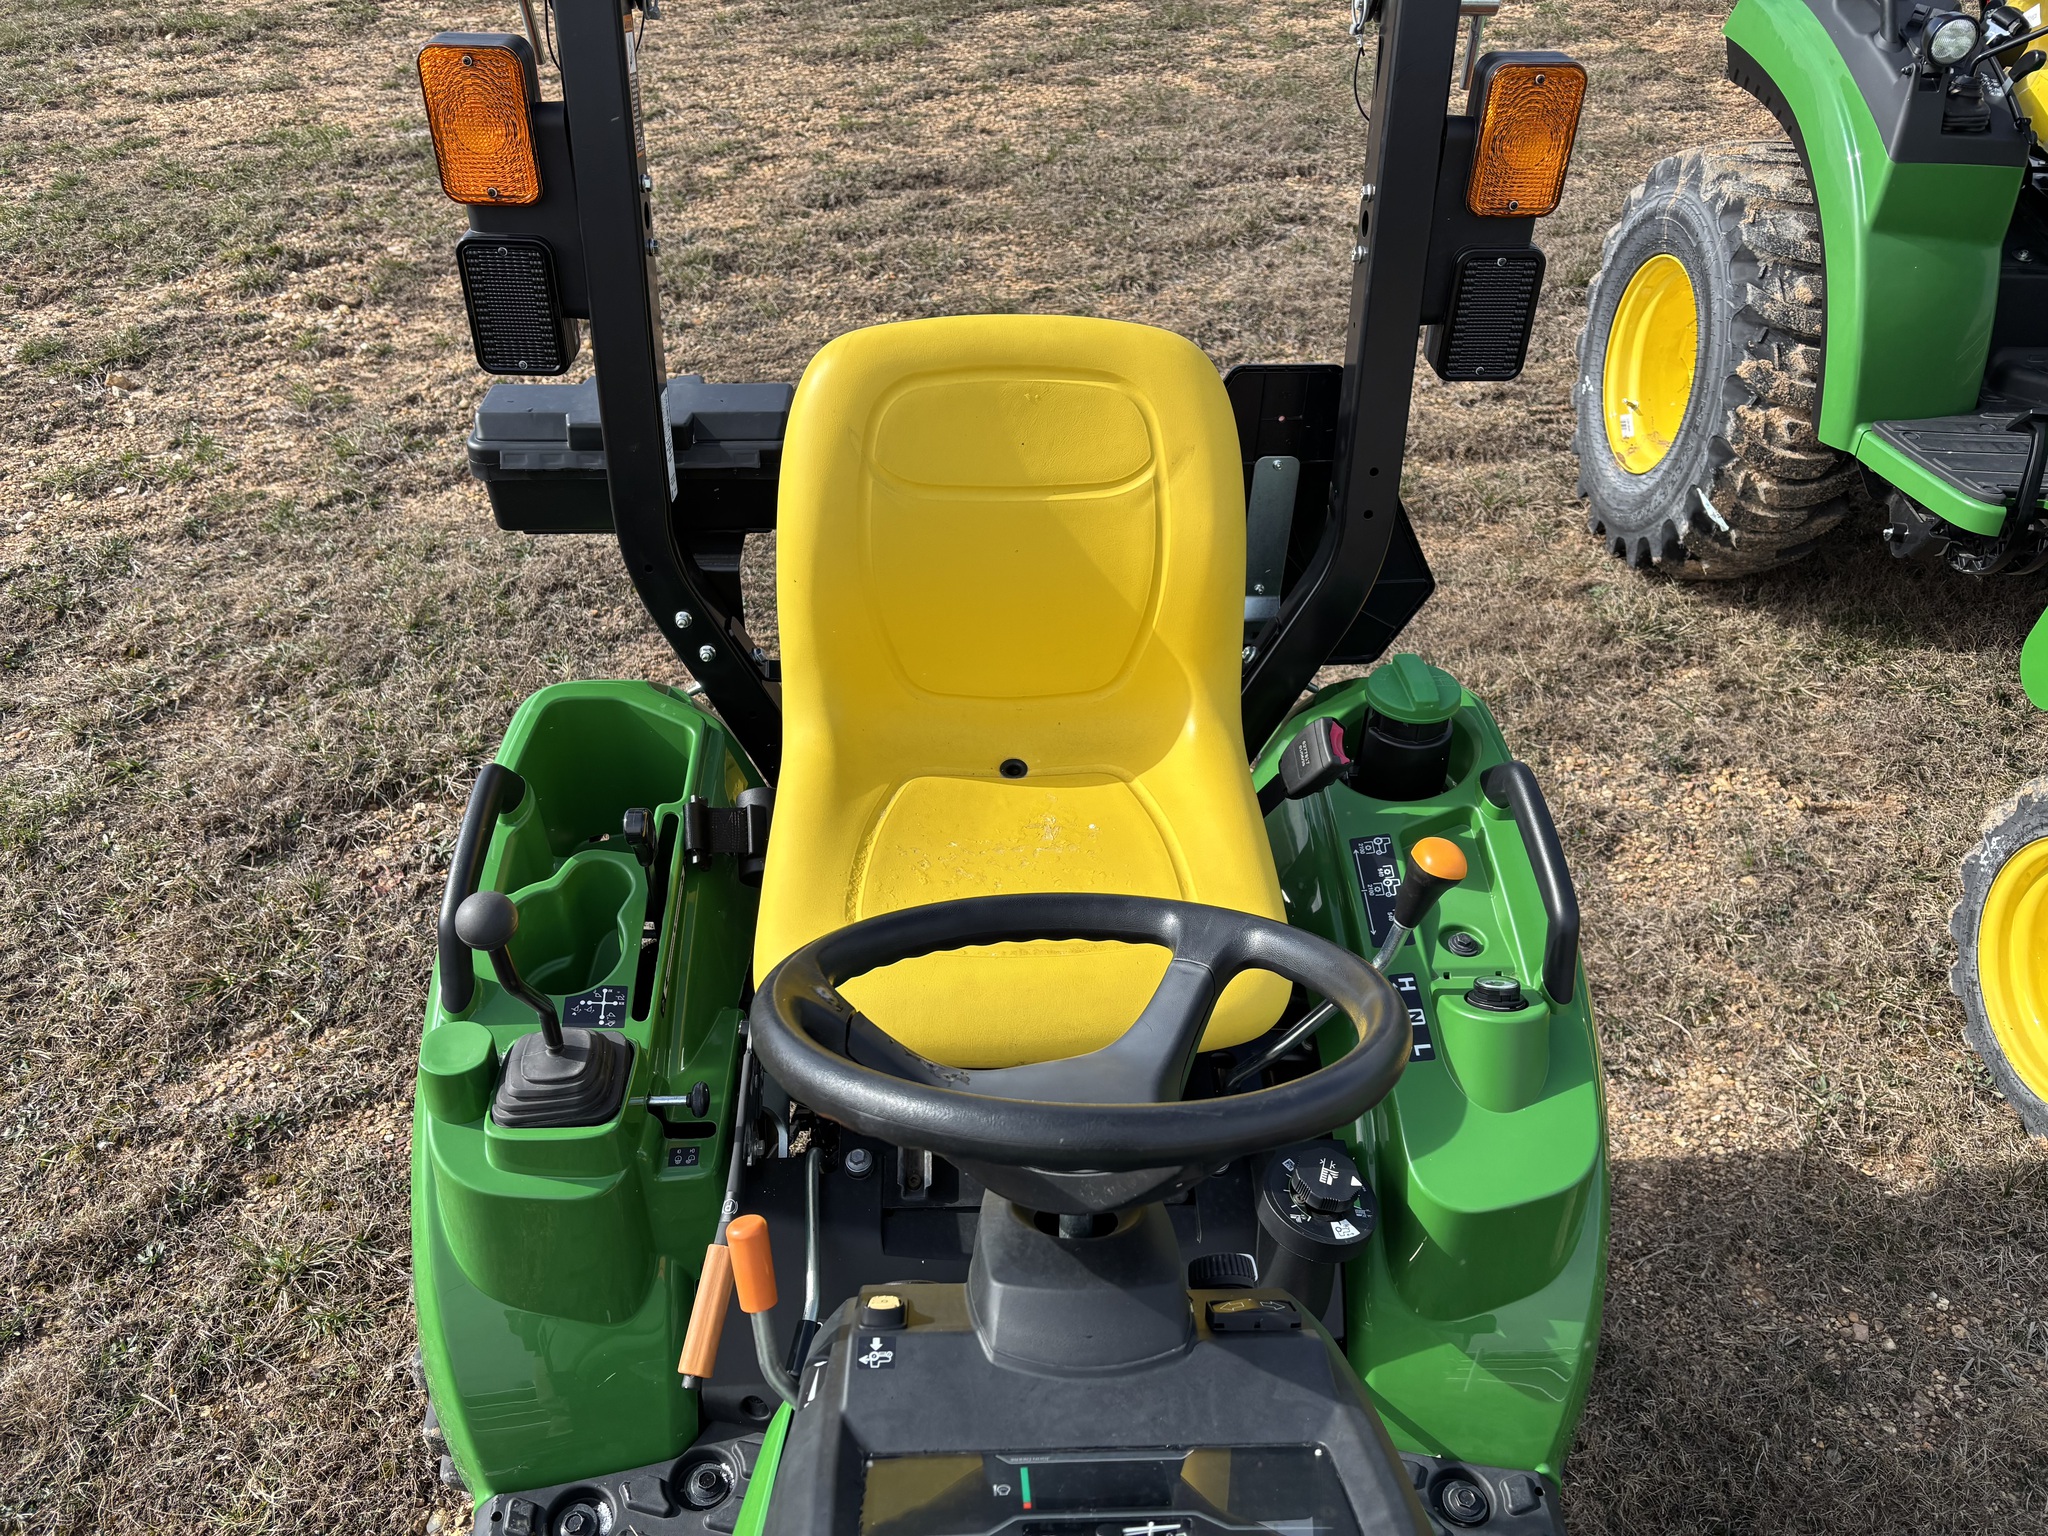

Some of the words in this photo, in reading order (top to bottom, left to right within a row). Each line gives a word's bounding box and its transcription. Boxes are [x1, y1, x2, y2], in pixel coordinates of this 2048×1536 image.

[1398, 977, 1417, 991] H
[1409, 1010, 1424, 1023] N
[1413, 1043, 1431, 1056] L
